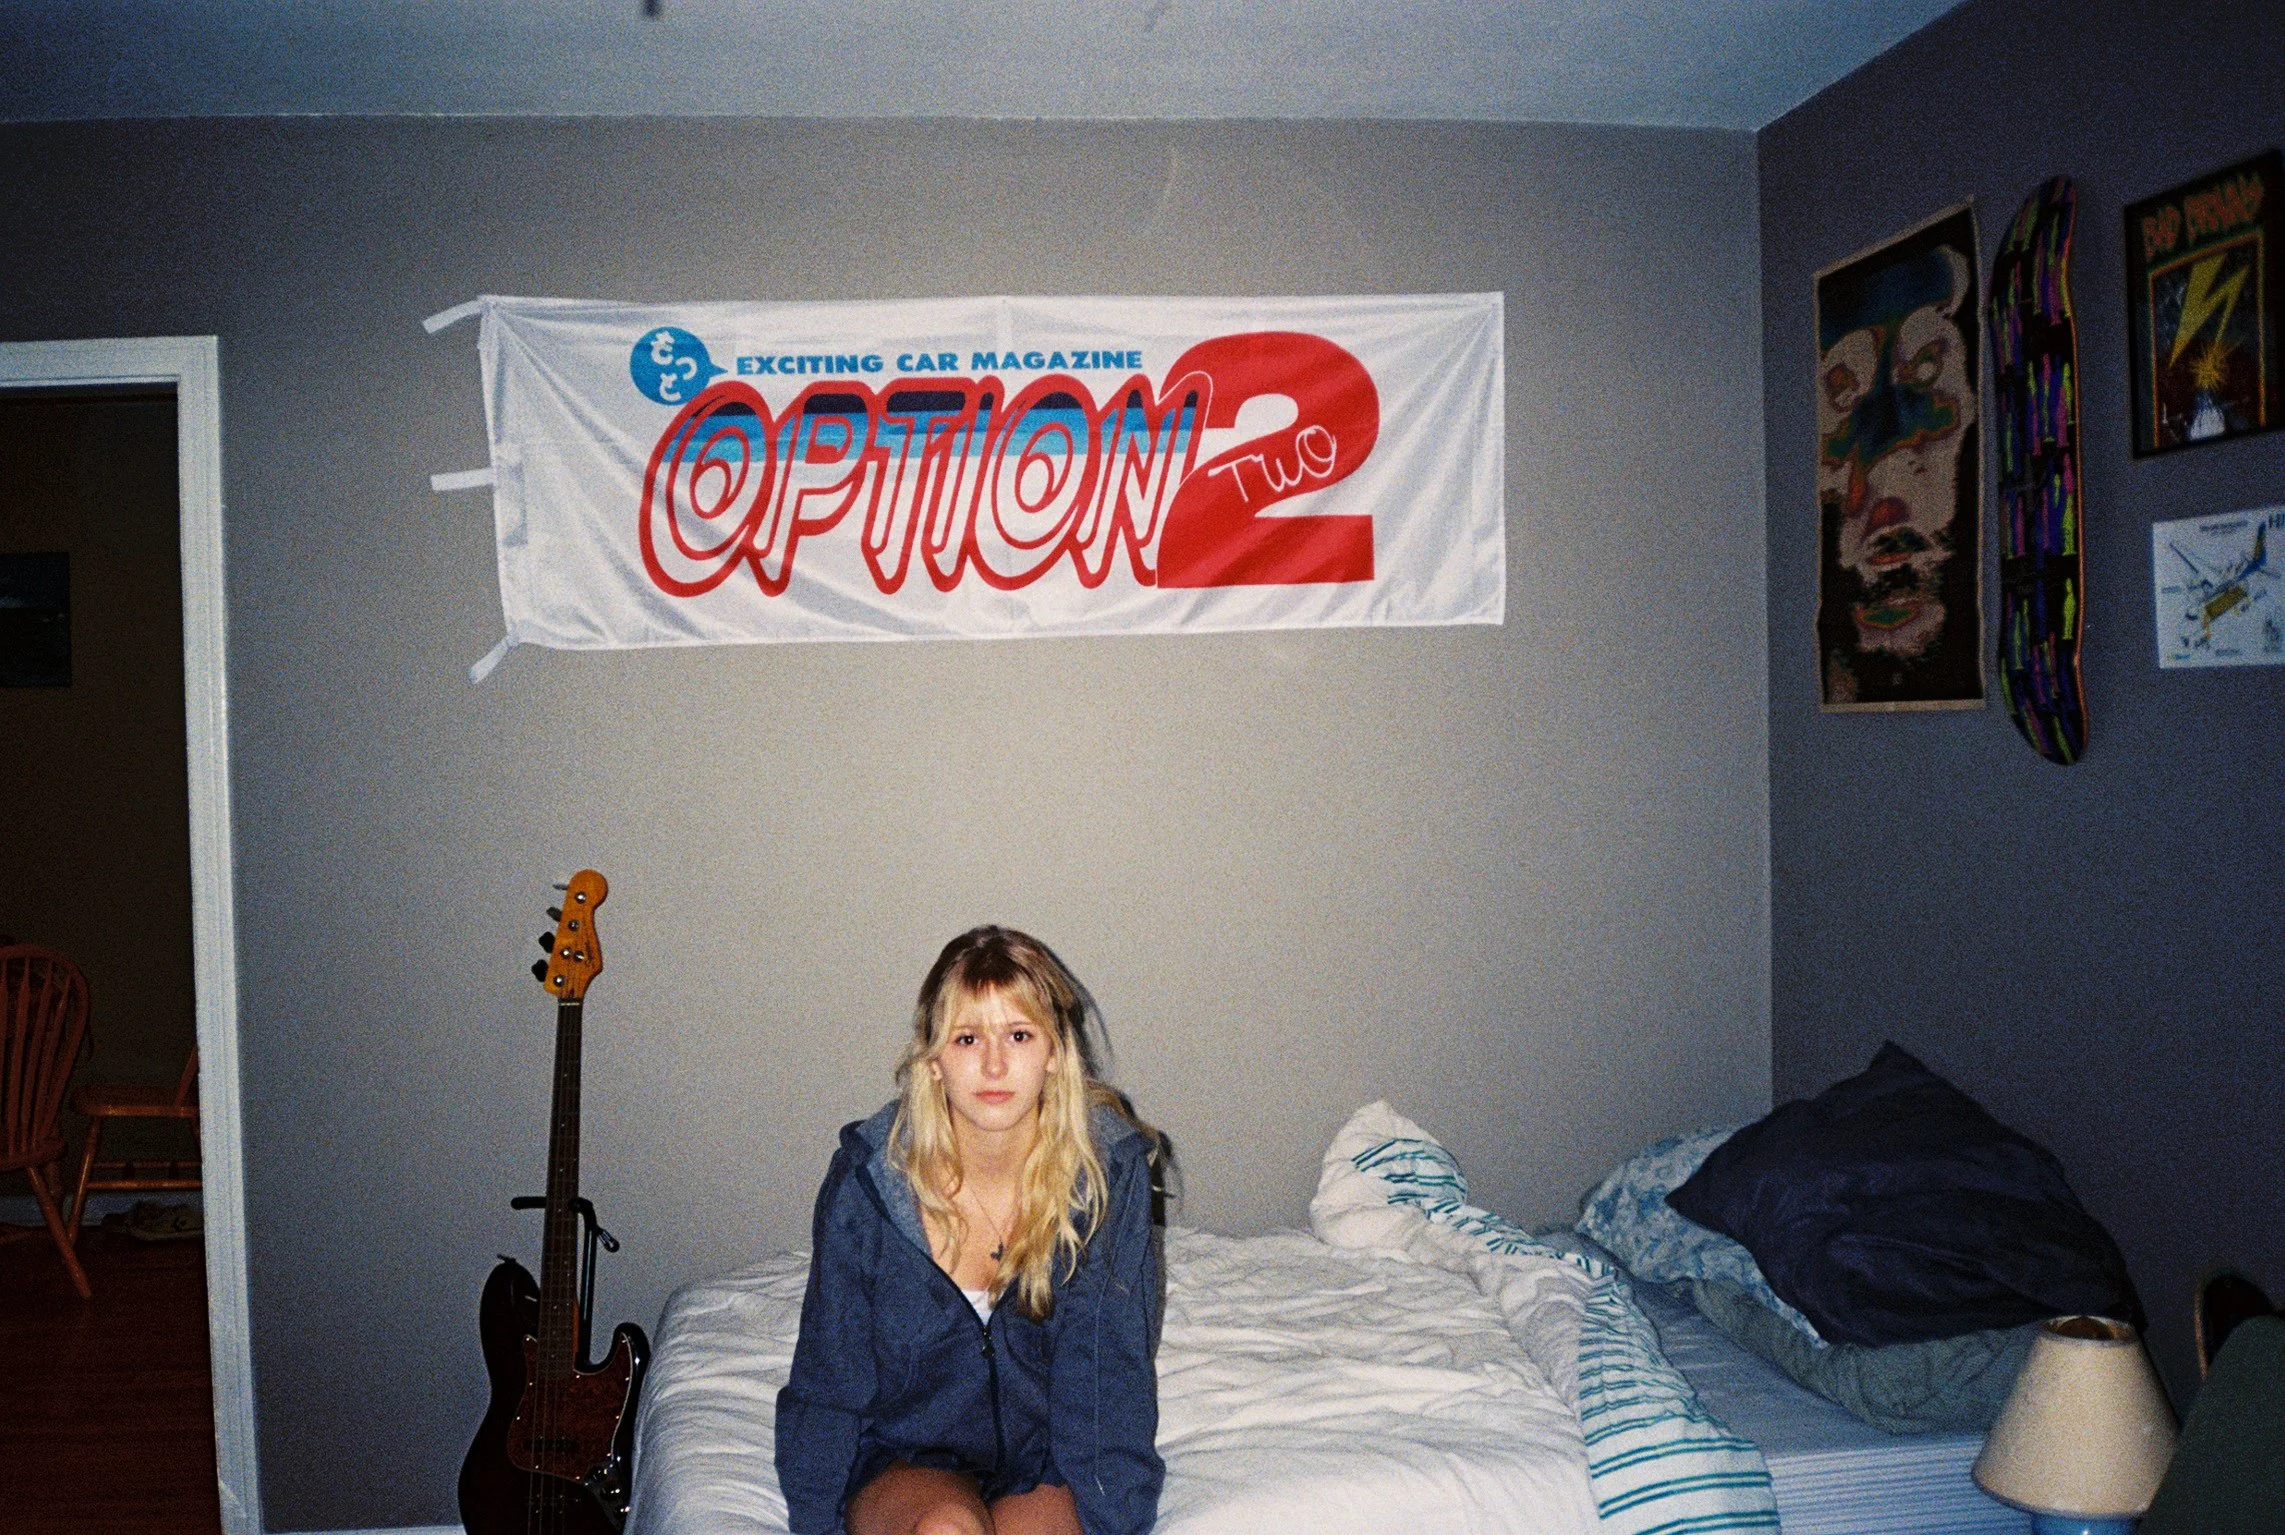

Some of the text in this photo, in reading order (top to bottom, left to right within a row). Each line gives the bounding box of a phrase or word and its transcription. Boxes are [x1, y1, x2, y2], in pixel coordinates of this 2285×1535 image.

[736, 349, 1143, 376] EXCITING CAR MAGAZINE
[638, 331, 1380, 598] OPTION 2
